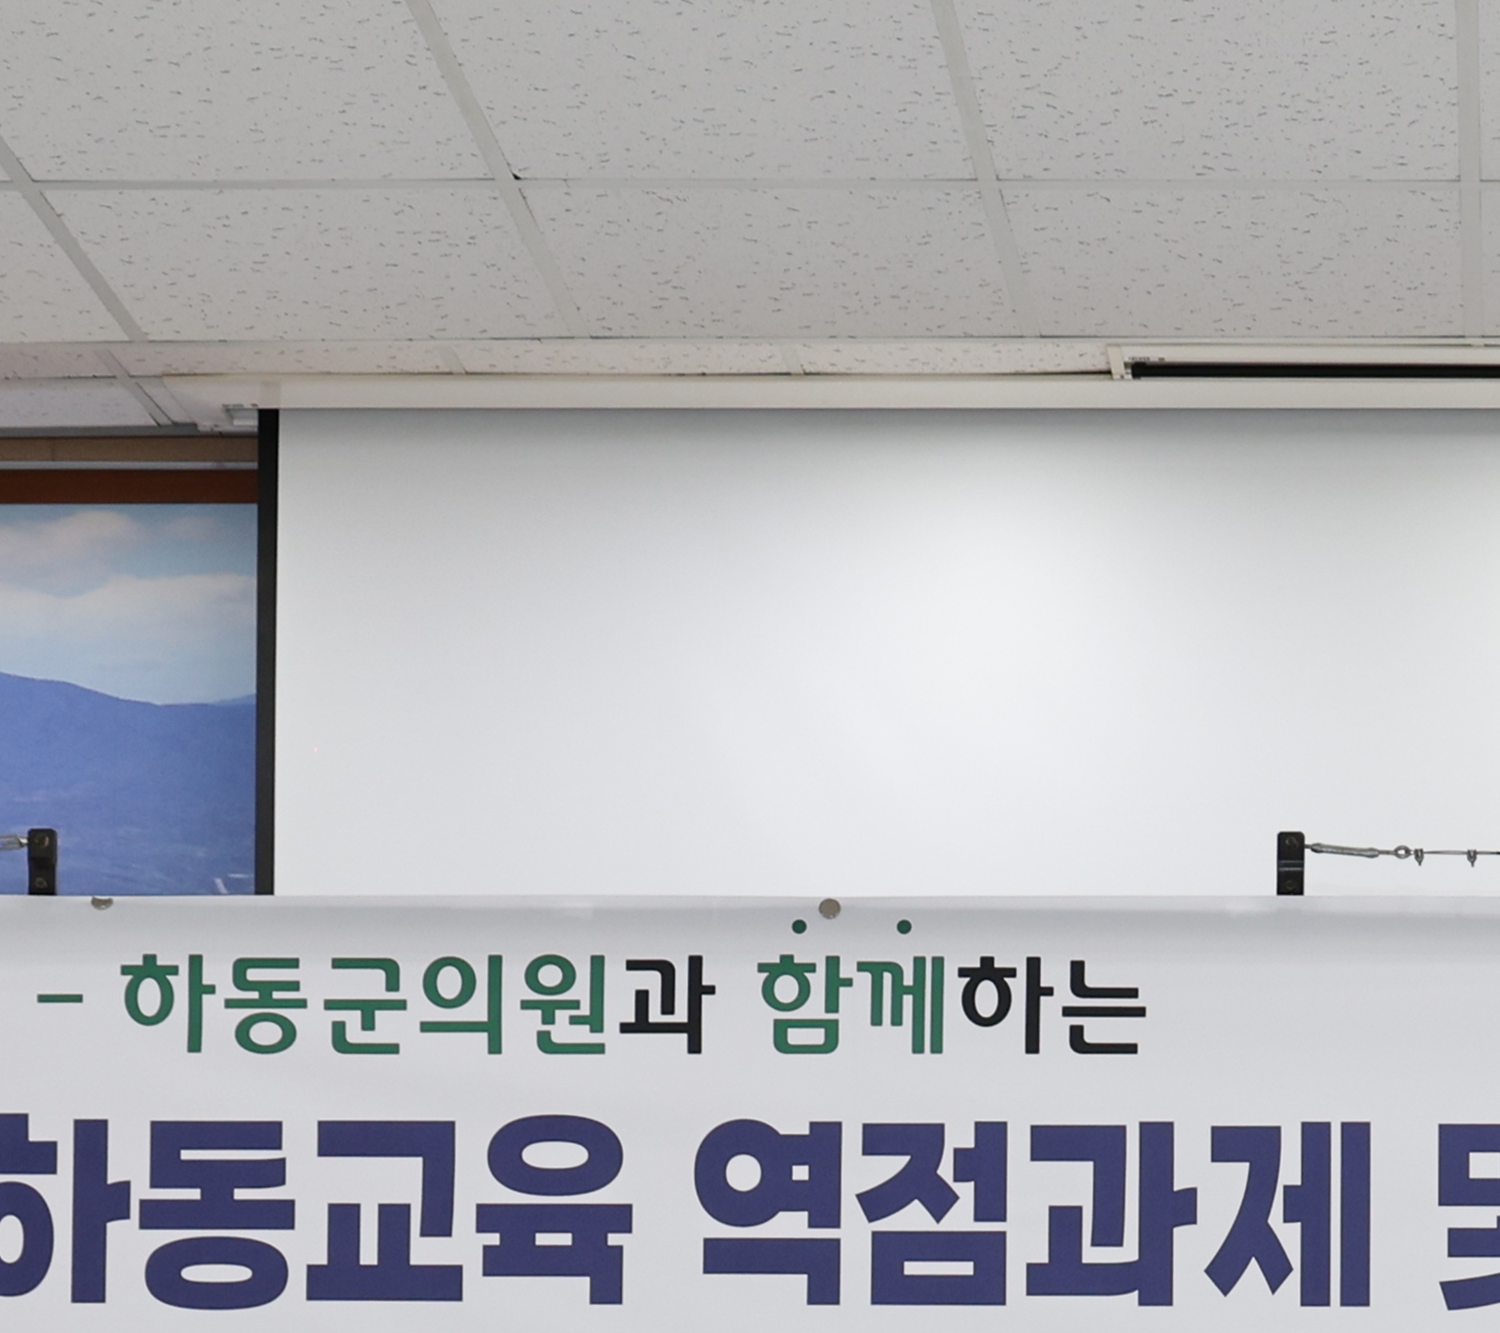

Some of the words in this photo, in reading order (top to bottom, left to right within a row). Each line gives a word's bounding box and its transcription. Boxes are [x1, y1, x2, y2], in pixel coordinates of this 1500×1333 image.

[121, 954, 716, 1055] 하동군의원과
[757, 950, 1146, 1055] 함께하는
[694, 1118, 1371, 1309] 역점과제
